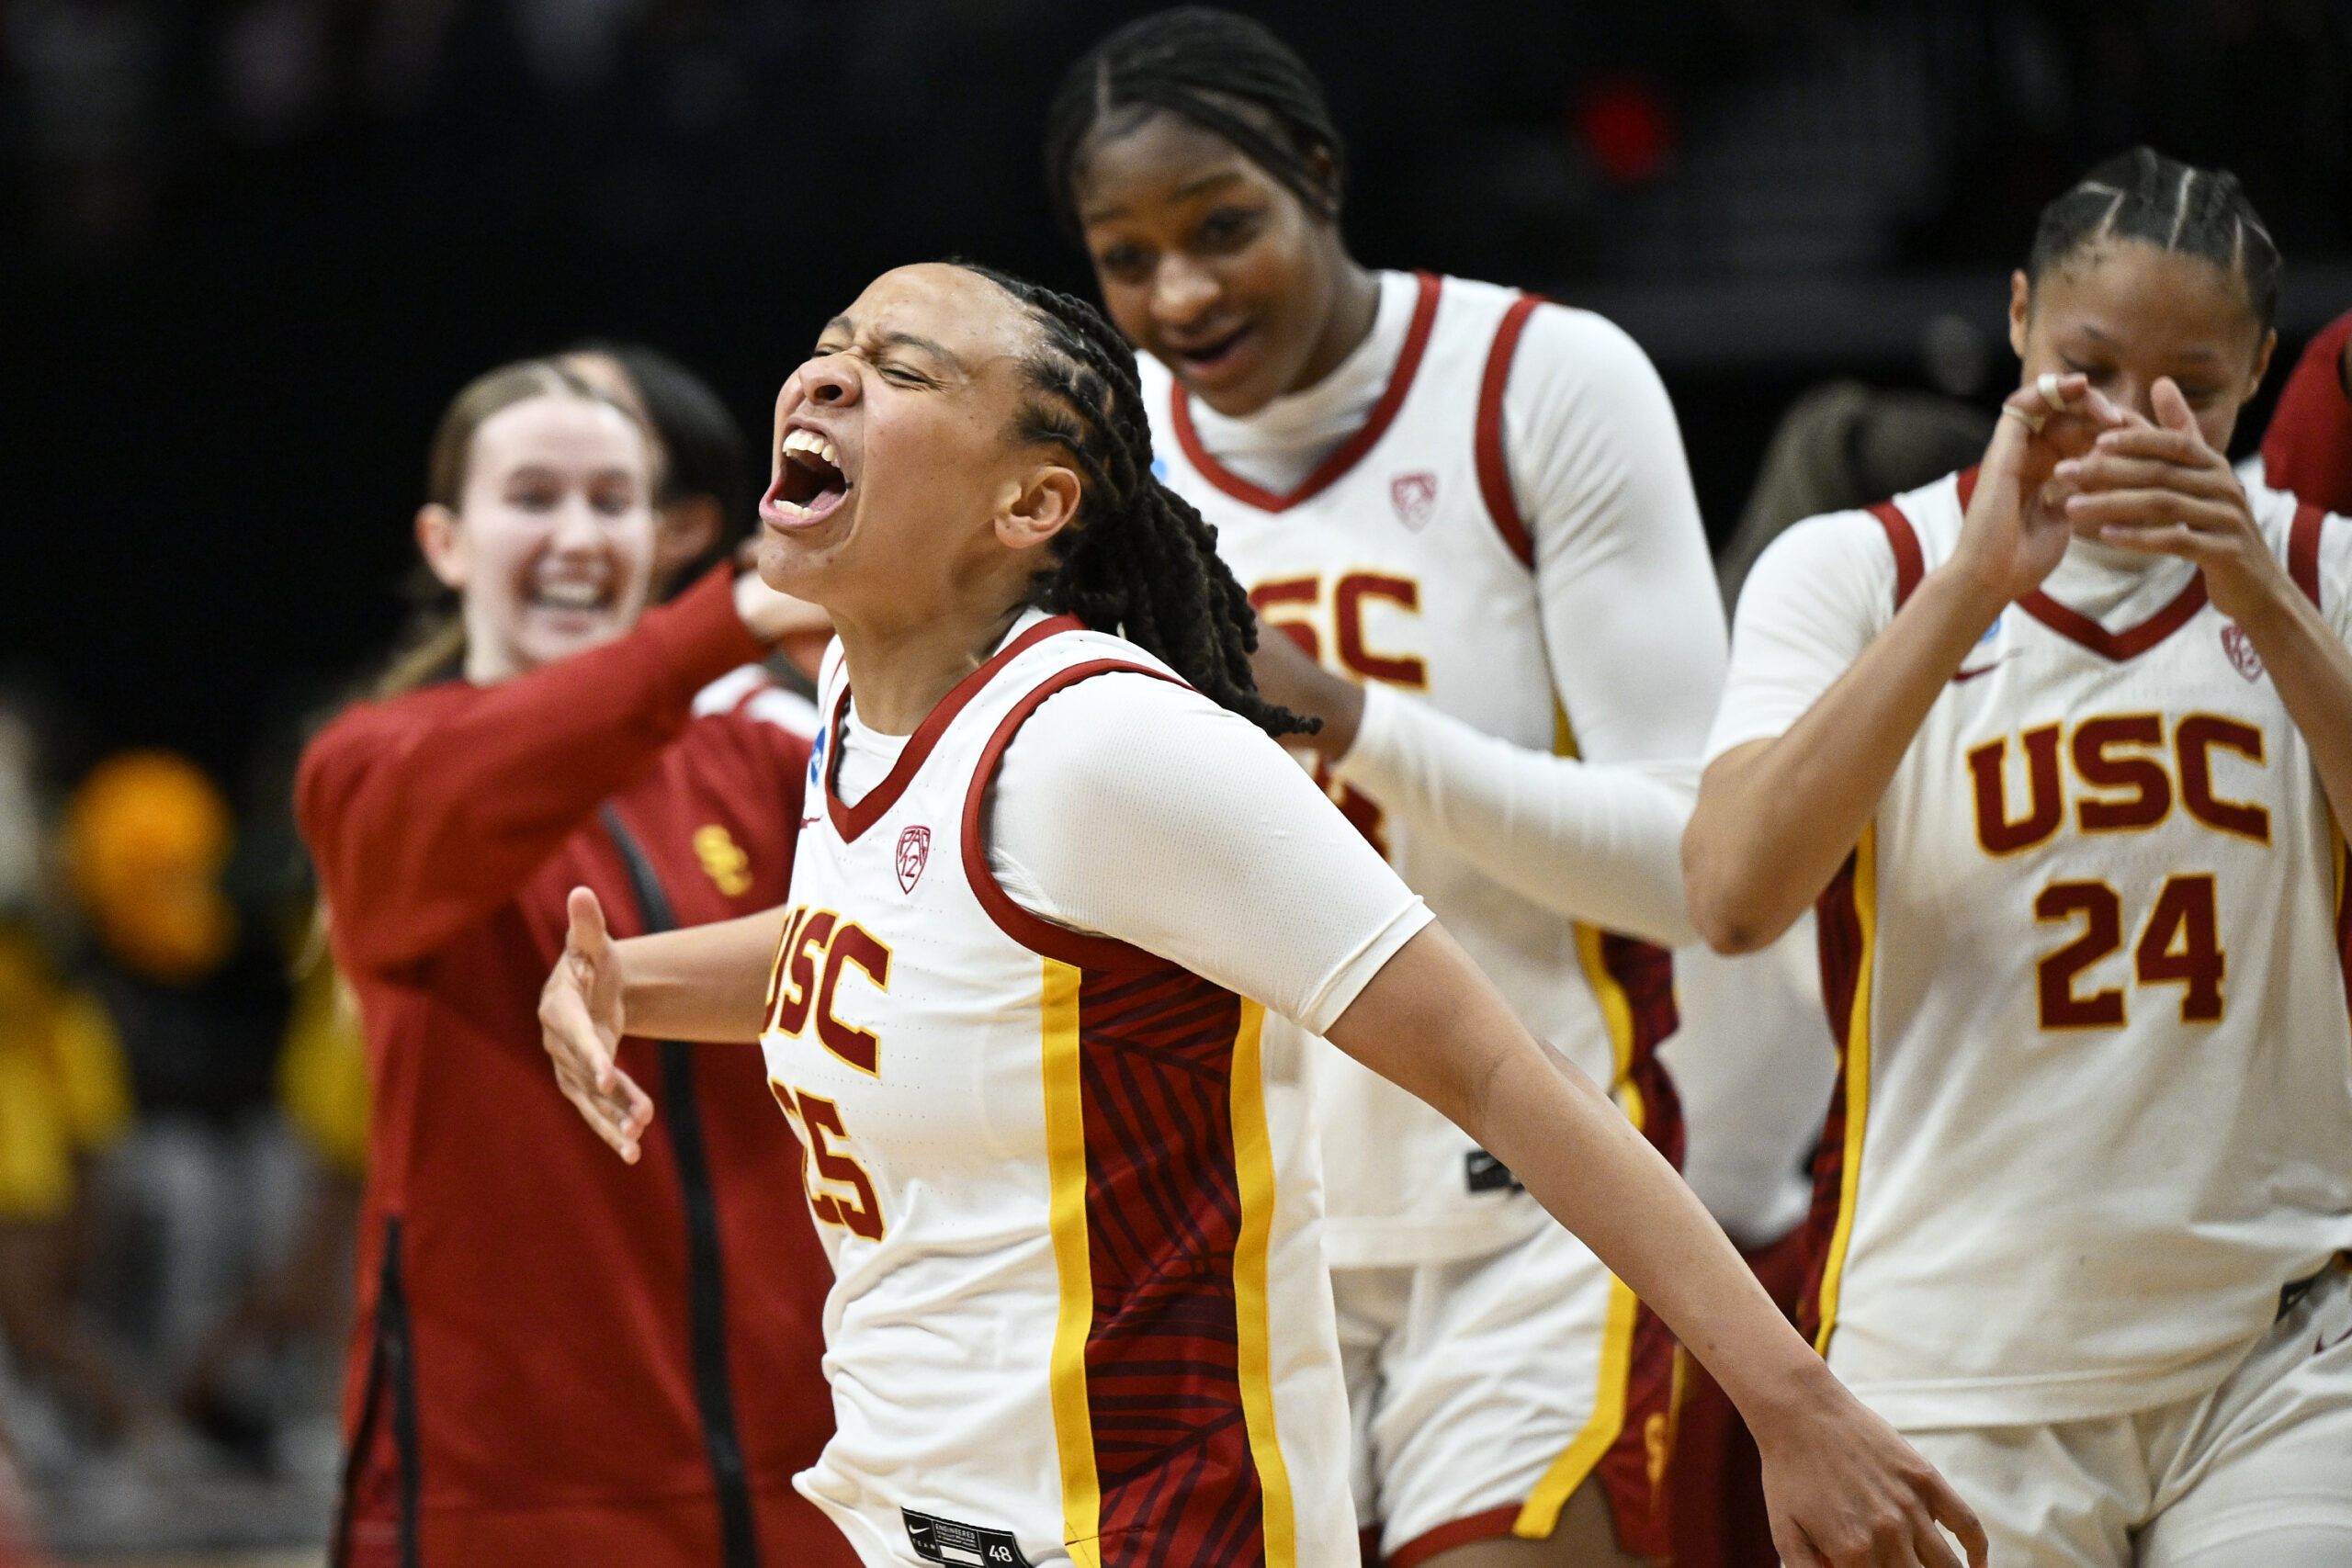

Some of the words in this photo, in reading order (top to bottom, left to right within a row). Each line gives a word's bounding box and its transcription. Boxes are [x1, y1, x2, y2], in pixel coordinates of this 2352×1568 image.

[1967, 708, 2273, 859] USC
[901, 854, 916, 878] 12
[2032, 871, 2226, 1031] 24
[989, 1544, 1013, 1562] 48
